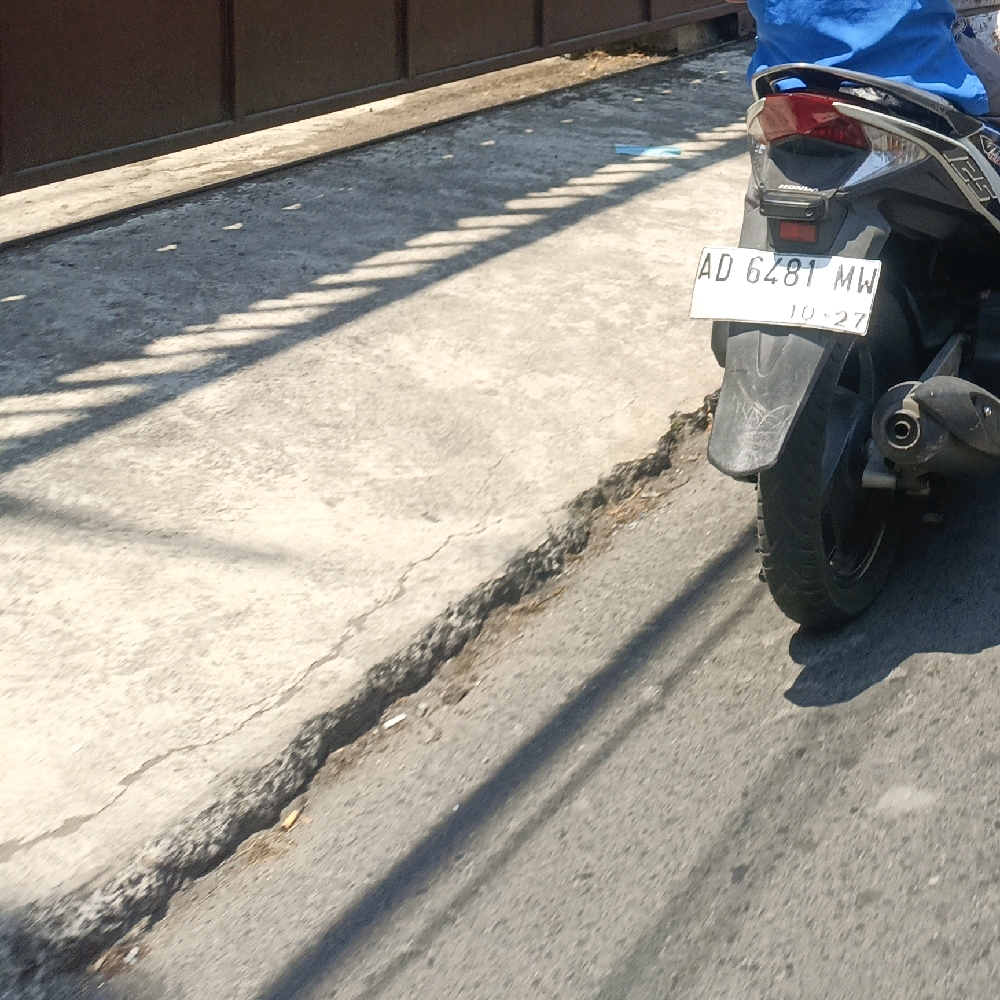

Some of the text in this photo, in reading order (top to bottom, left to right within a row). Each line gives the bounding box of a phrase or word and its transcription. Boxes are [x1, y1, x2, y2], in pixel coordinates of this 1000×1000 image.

[943, 153, 998, 201] 125
[698, 252, 877, 294] AD 6481 MW
